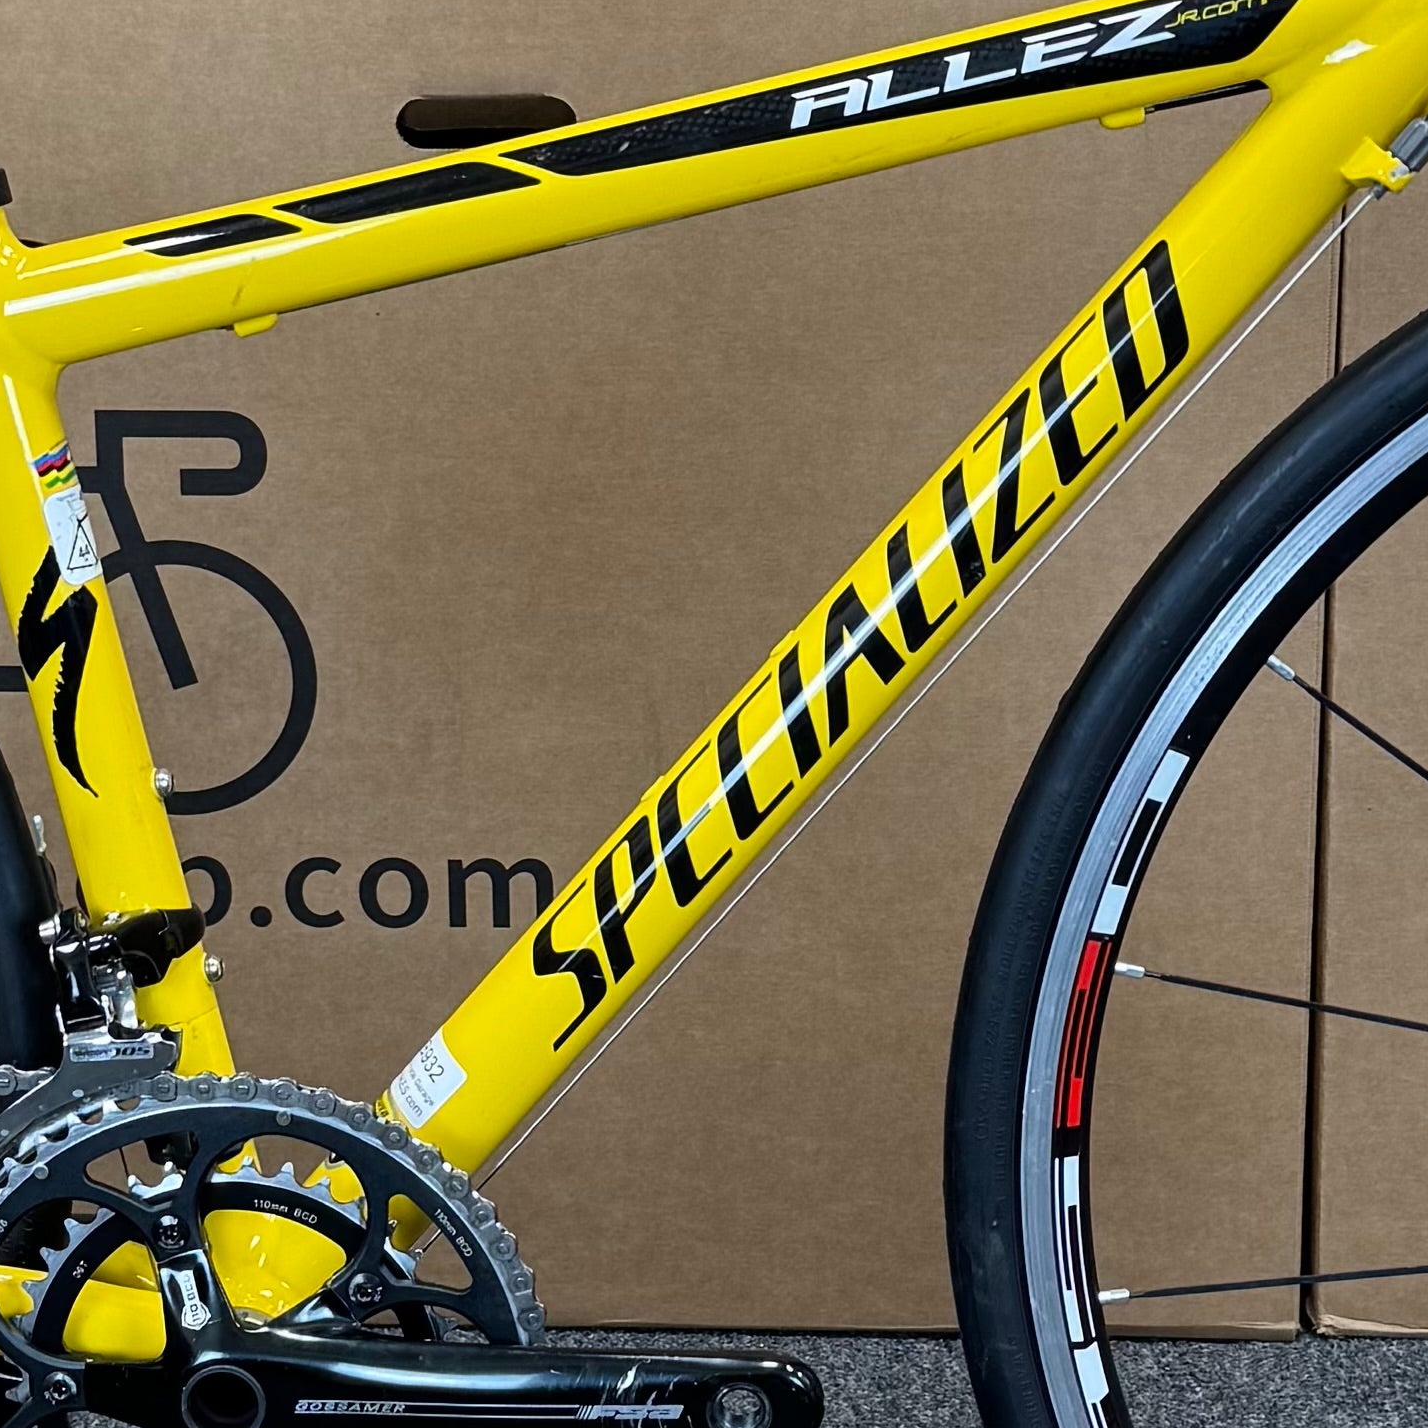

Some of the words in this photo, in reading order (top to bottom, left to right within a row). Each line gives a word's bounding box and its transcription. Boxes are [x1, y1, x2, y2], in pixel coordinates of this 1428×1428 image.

[789, 0, 1184, 131] ALLEZ
[530, 238, 1191, 1051] SPECIALIZED
[293, 1207, 319, 1225] BCD
[455, 1235, 474, 1258] BCD
[295, 1401, 407, 1414] GOSSAMER
